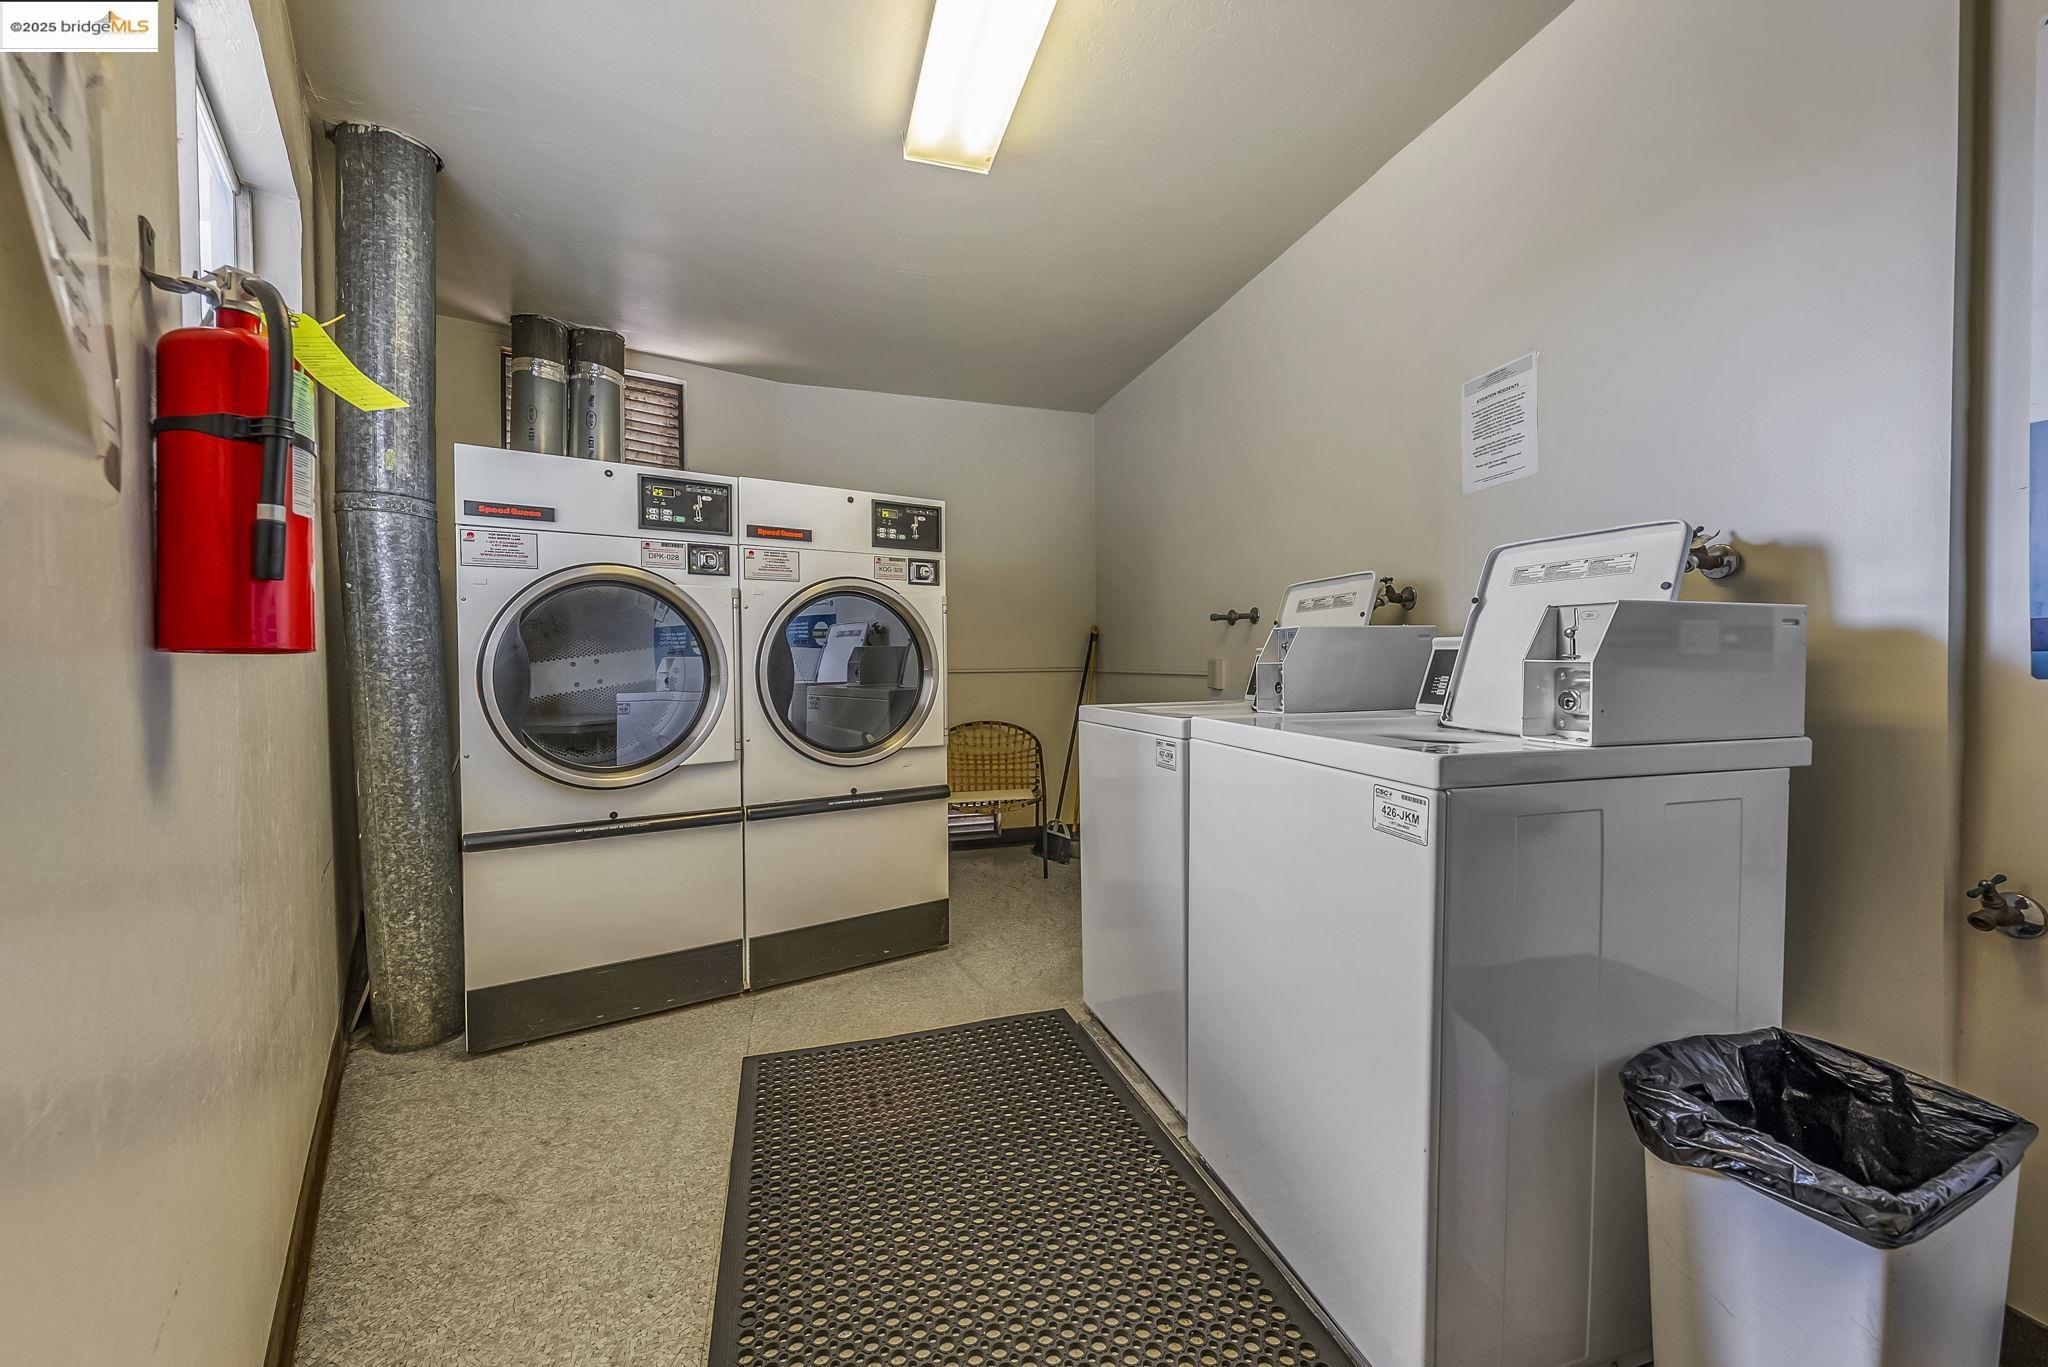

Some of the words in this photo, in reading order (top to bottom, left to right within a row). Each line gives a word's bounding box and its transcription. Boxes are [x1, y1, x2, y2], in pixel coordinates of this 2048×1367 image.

[652, 488, 663, 496] 25
[479, 505, 510, 514] Speed
[511, 508, 541, 517] Queen
[757, 528, 780, 536] Speed
[780, 530, 803, 538] Queen
[1381, 805, 1420, 826] 426-JKM
